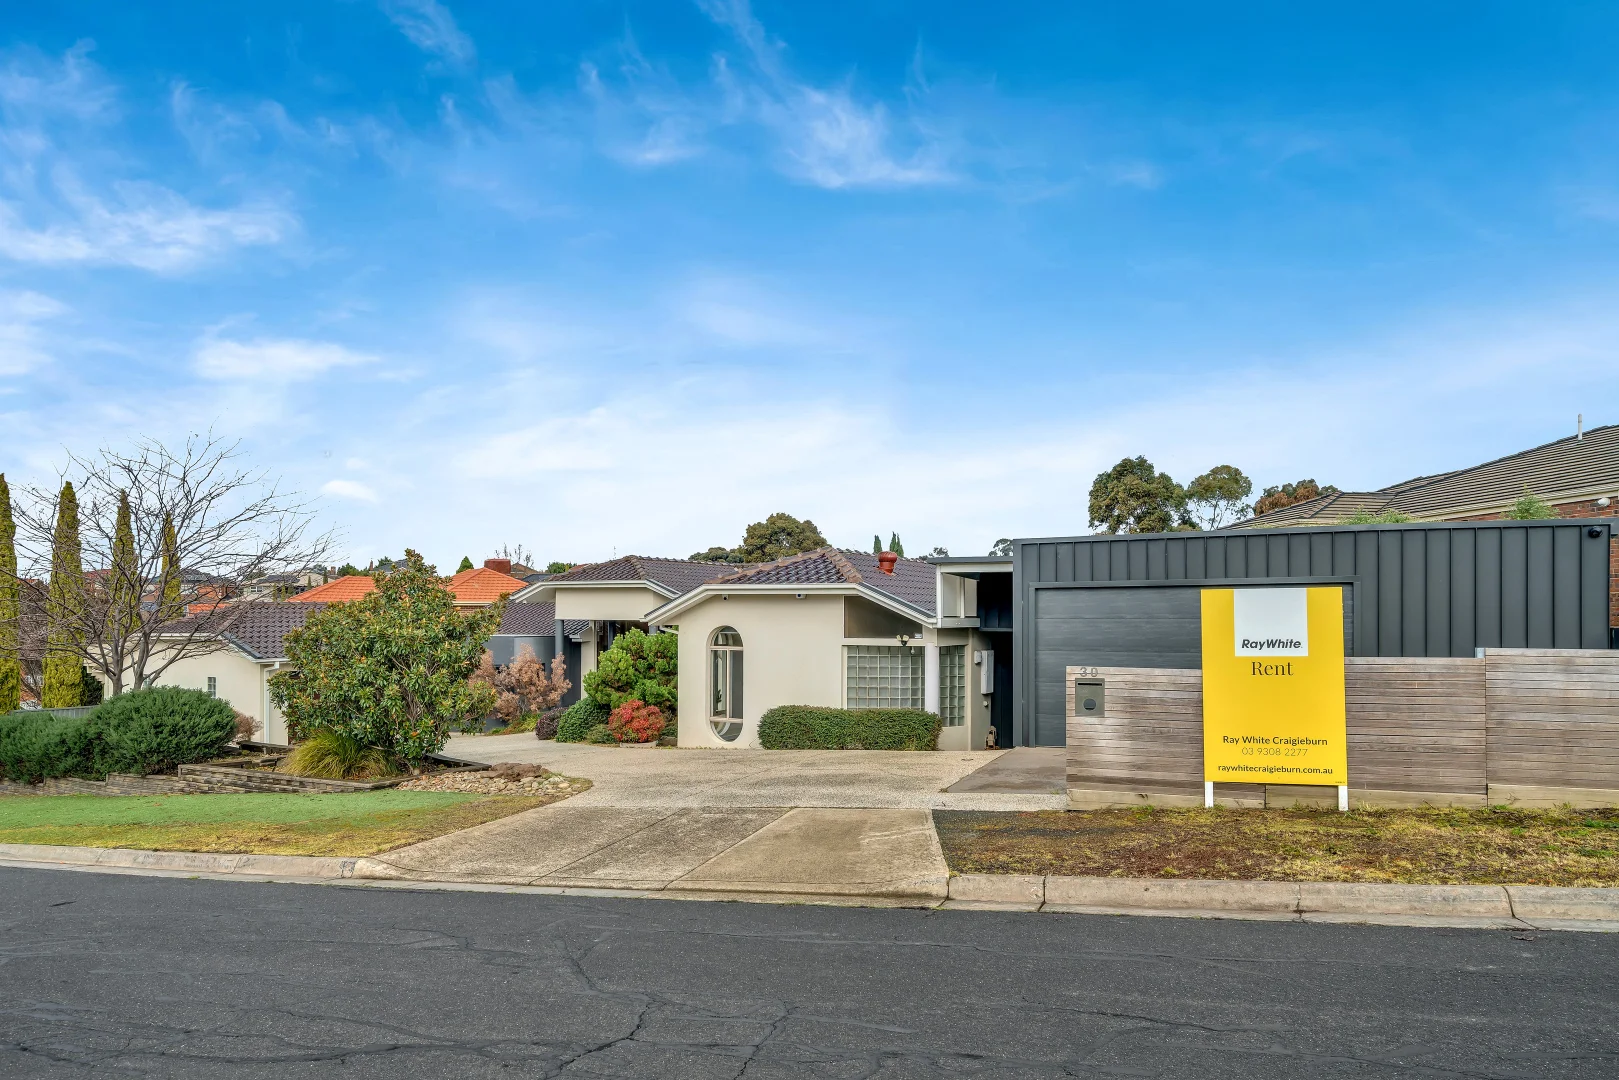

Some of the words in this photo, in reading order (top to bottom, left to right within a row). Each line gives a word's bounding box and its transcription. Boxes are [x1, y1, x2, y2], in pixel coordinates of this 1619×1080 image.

[1250, 661, 1295, 676] Rent
[1222, 735, 1240, 745] Ray
[1241, 736, 1271, 745] White
[1272, 736, 1328, 747] Craigieburn
[1241, 747, 1254, 756] 03
[1257, 747, 1281, 757] 9308
[1284, 748, 1309, 757] 2277
[1217, 764, 1333, 775] raywhitecraigieburn.com.au
